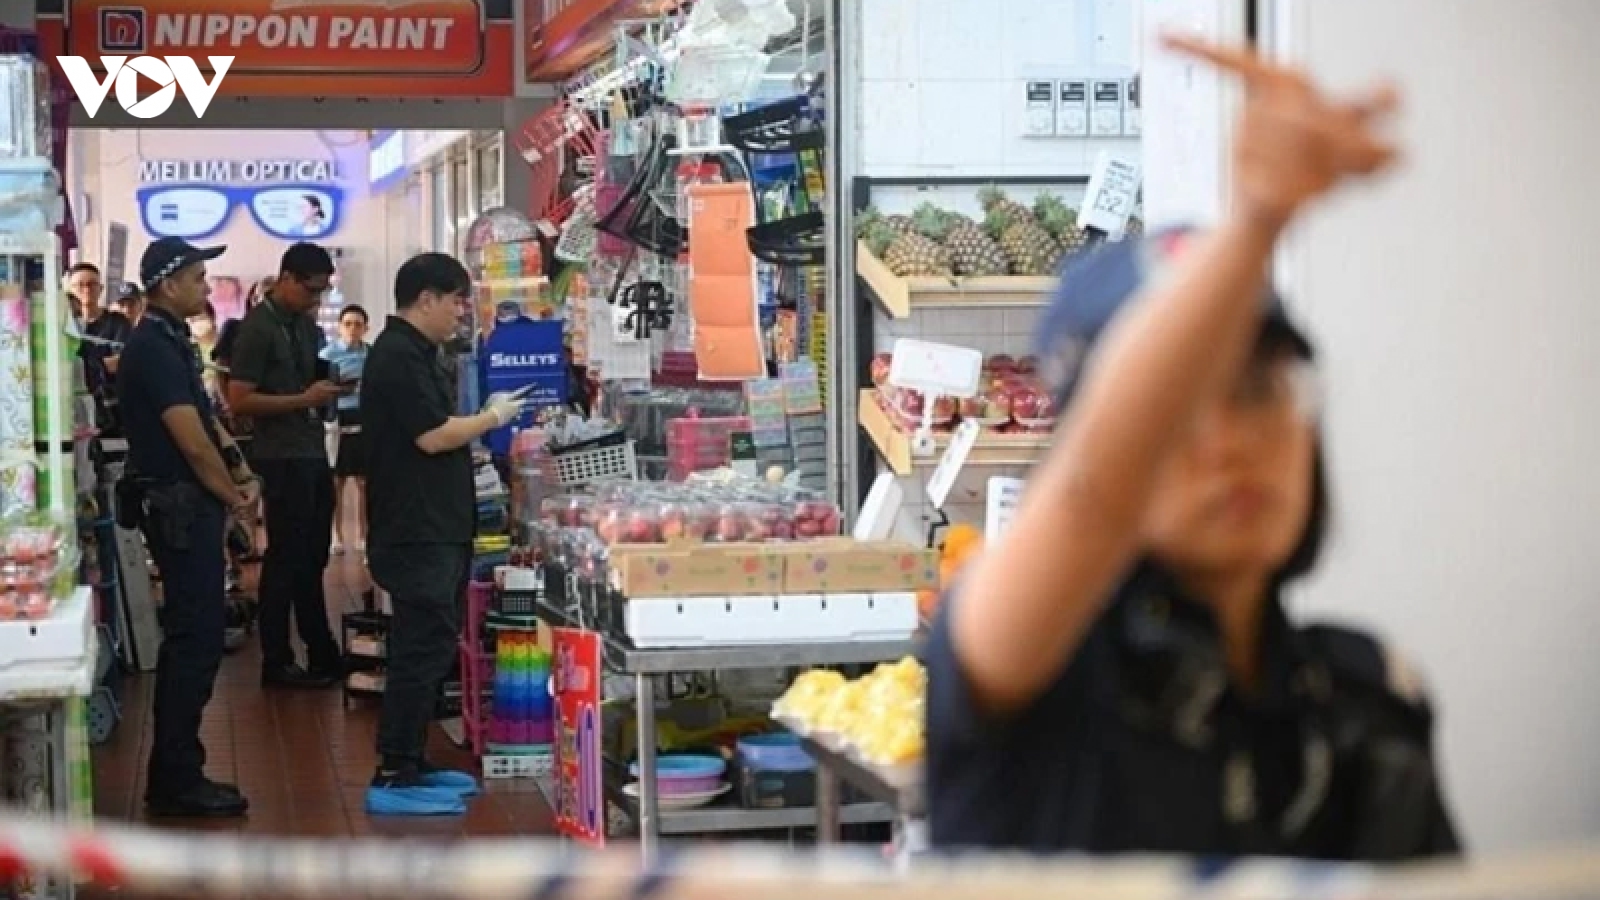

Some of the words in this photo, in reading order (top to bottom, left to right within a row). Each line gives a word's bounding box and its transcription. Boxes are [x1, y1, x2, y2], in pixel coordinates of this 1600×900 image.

[154, 14, 318, 48] NIPPON
[328, 17, 454, 49] PAINT
[138, 161, 179, 182] MEI
[188, 161, 231, 182] LIM
[241, 161, 341, 182] OPTICAL
